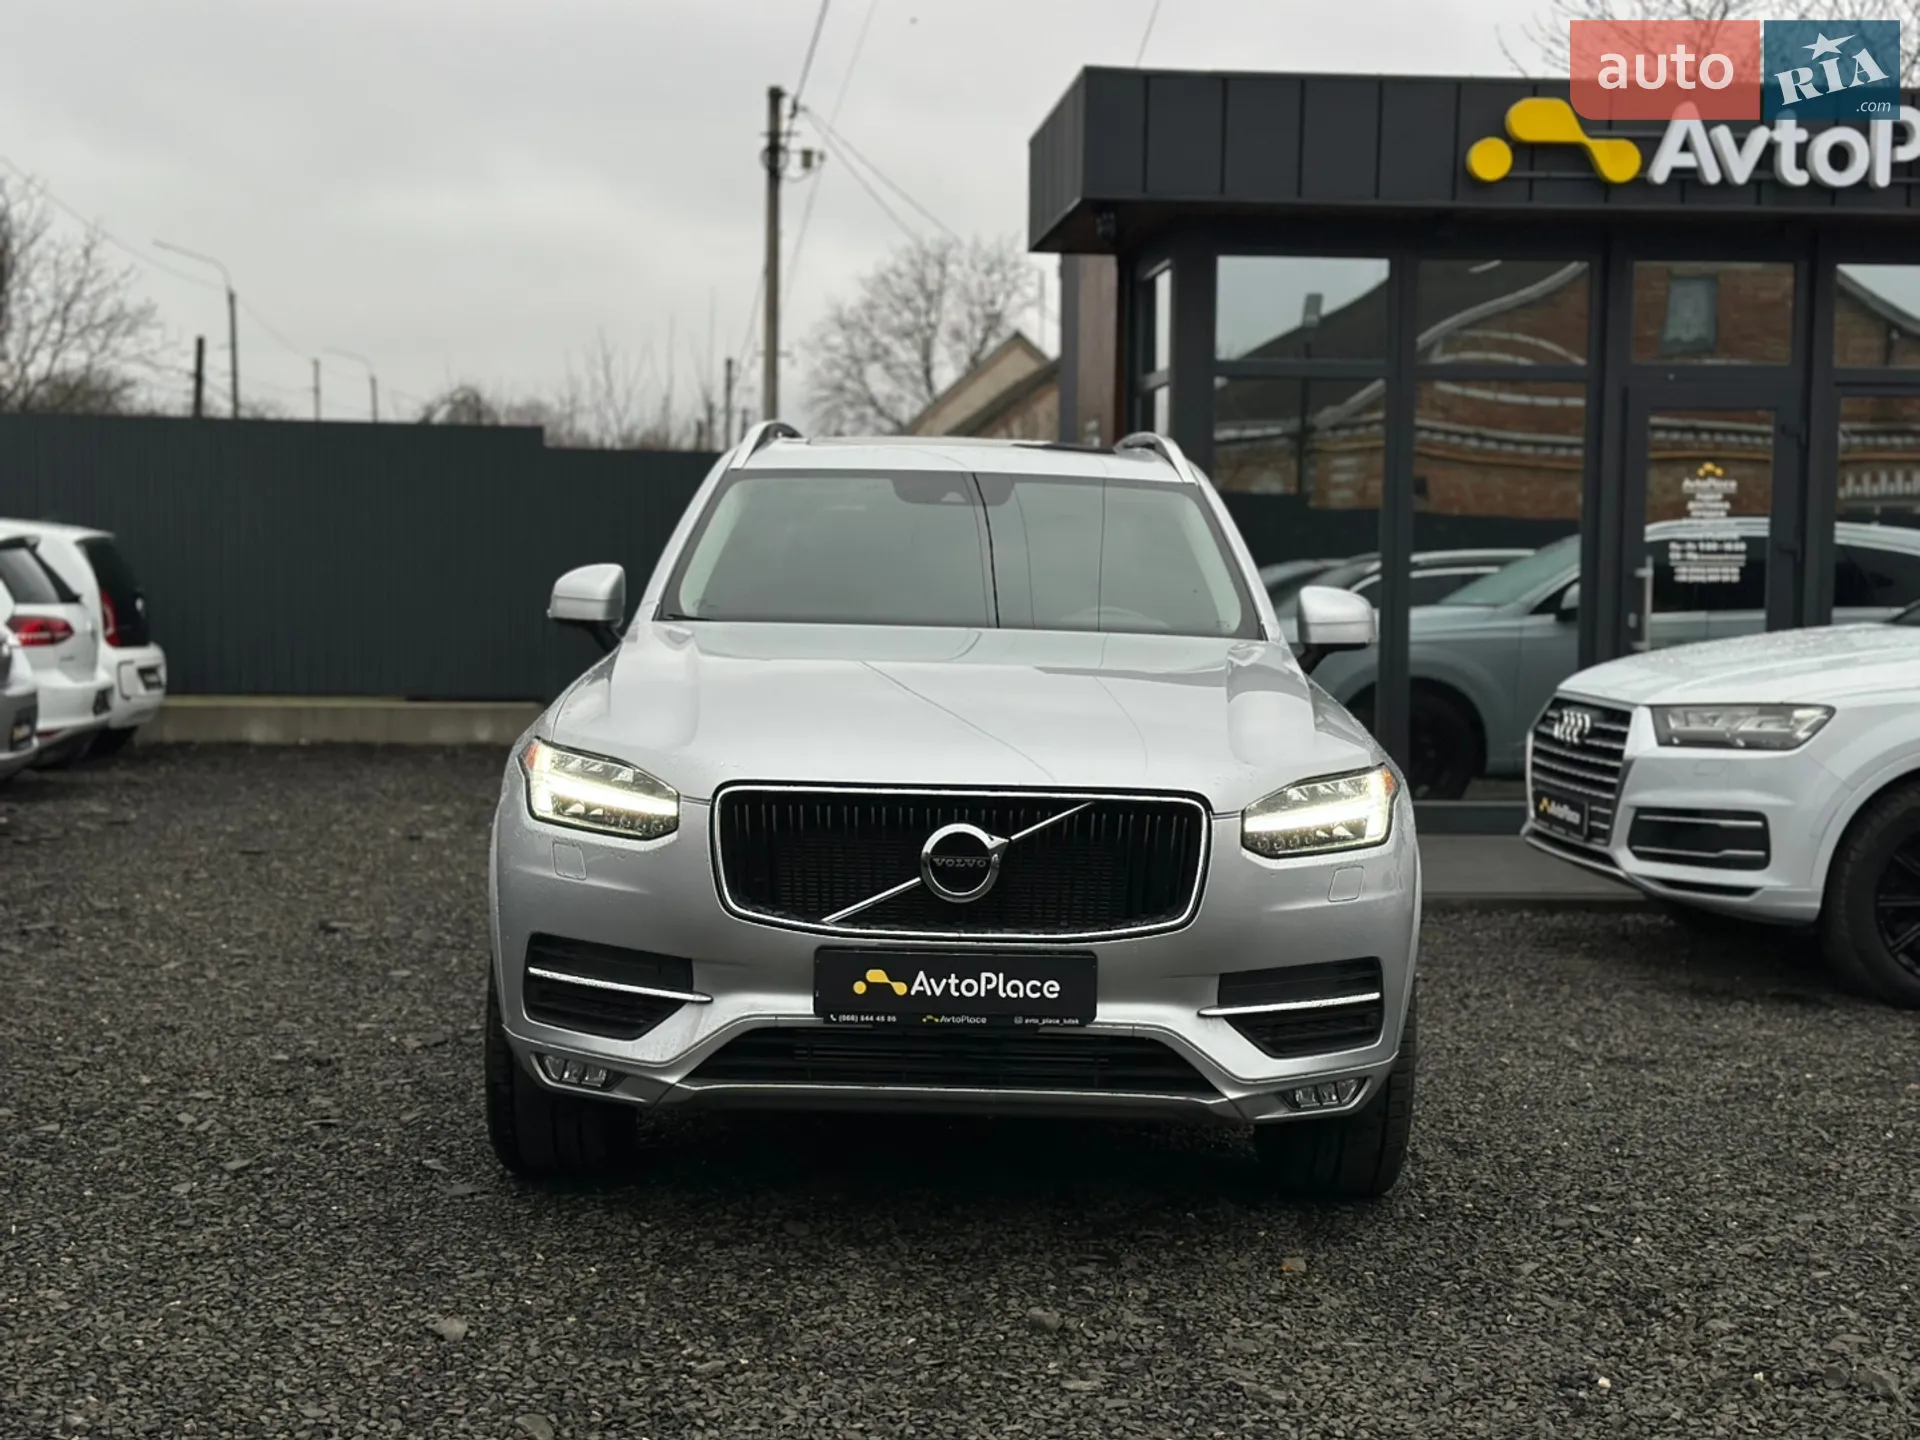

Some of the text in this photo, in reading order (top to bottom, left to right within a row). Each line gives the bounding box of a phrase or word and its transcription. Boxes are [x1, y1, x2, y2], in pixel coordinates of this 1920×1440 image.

[932, 857, 987, 868] VOLVO
[910, 970, 1061, 998] AvtoPlace
[940, 1015, 987, 1024] AvtoPlace
